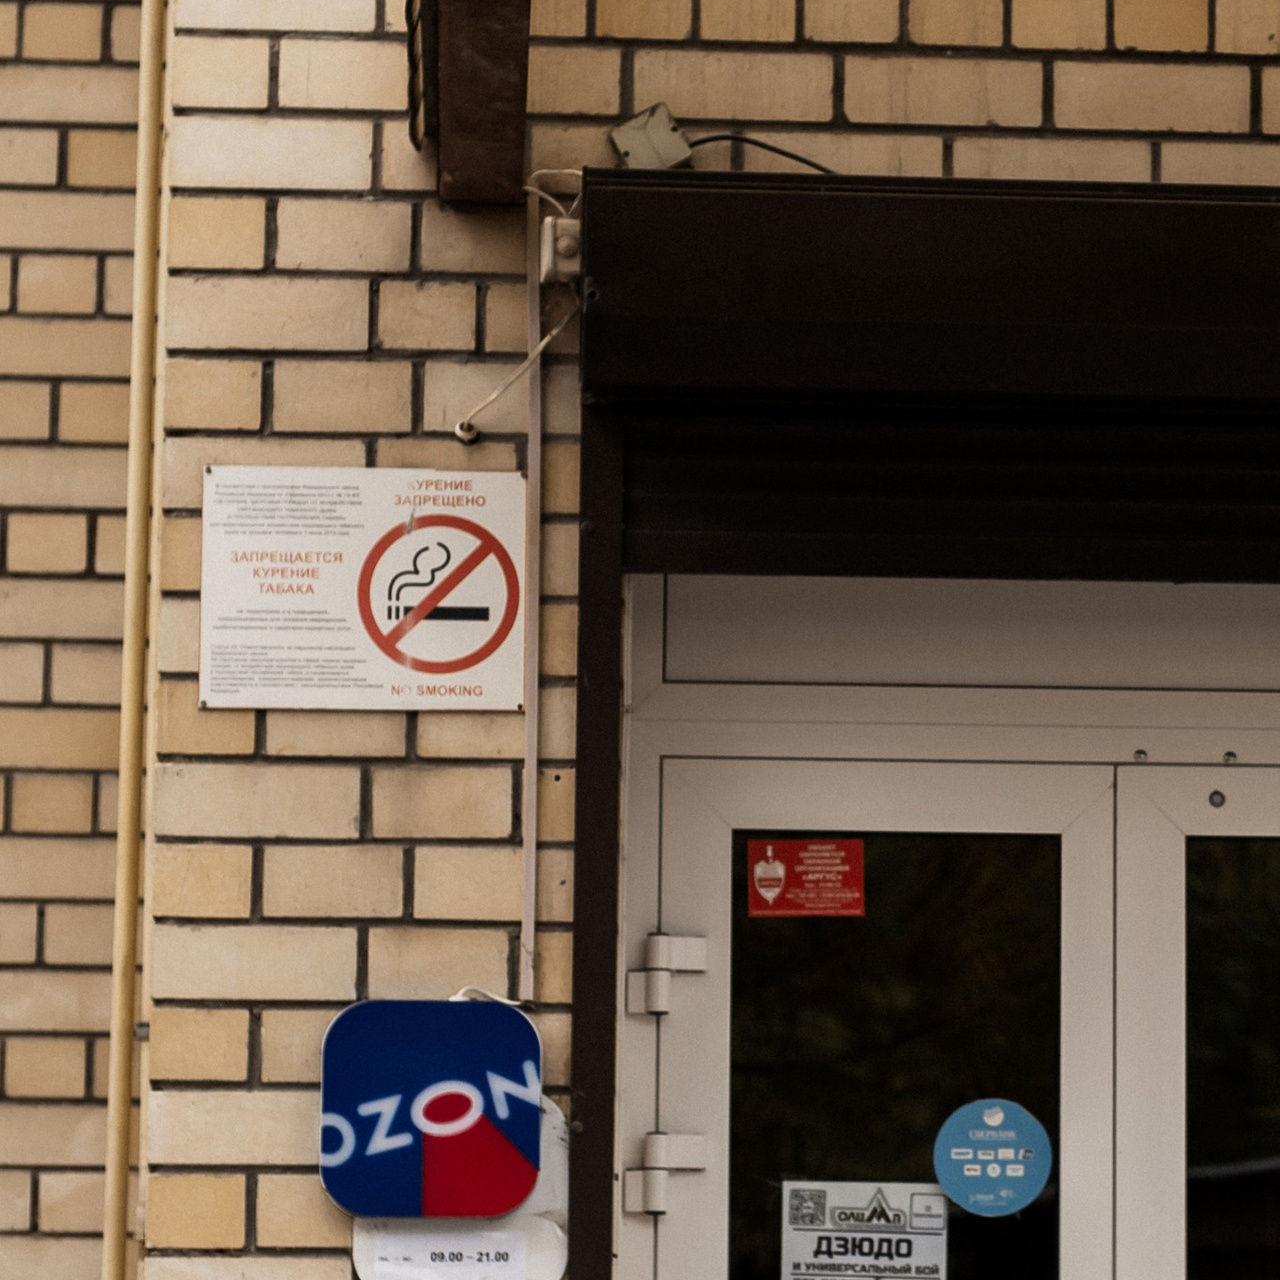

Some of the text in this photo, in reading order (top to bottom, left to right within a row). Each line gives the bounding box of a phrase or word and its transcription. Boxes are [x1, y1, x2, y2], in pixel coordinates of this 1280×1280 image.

[407, 478, 473, 491] КУРЕНИЕ
[393, 493, 487, 508] ЗАПРЕЩЕНО
[230, 551, 344, 565] ЗАПРЕЩАЕТСЯ
[252, 567, 320, 579] КУРЕНИЕ
[258, 582, 316, 595] ТАБАКА
[416, 684, 484, 697] SMOKING
[320, 1059, 542, 1168] OZON
[812, 1235, 913, 1261] ДЗЮДО
[430, 1251, 464, 1262] 09.00
[476, 1251, 510, 1262] 21.00
[792, 1261, 940, 1275] И УНИВЕРСАЛЬНЫЙ БОЙ
